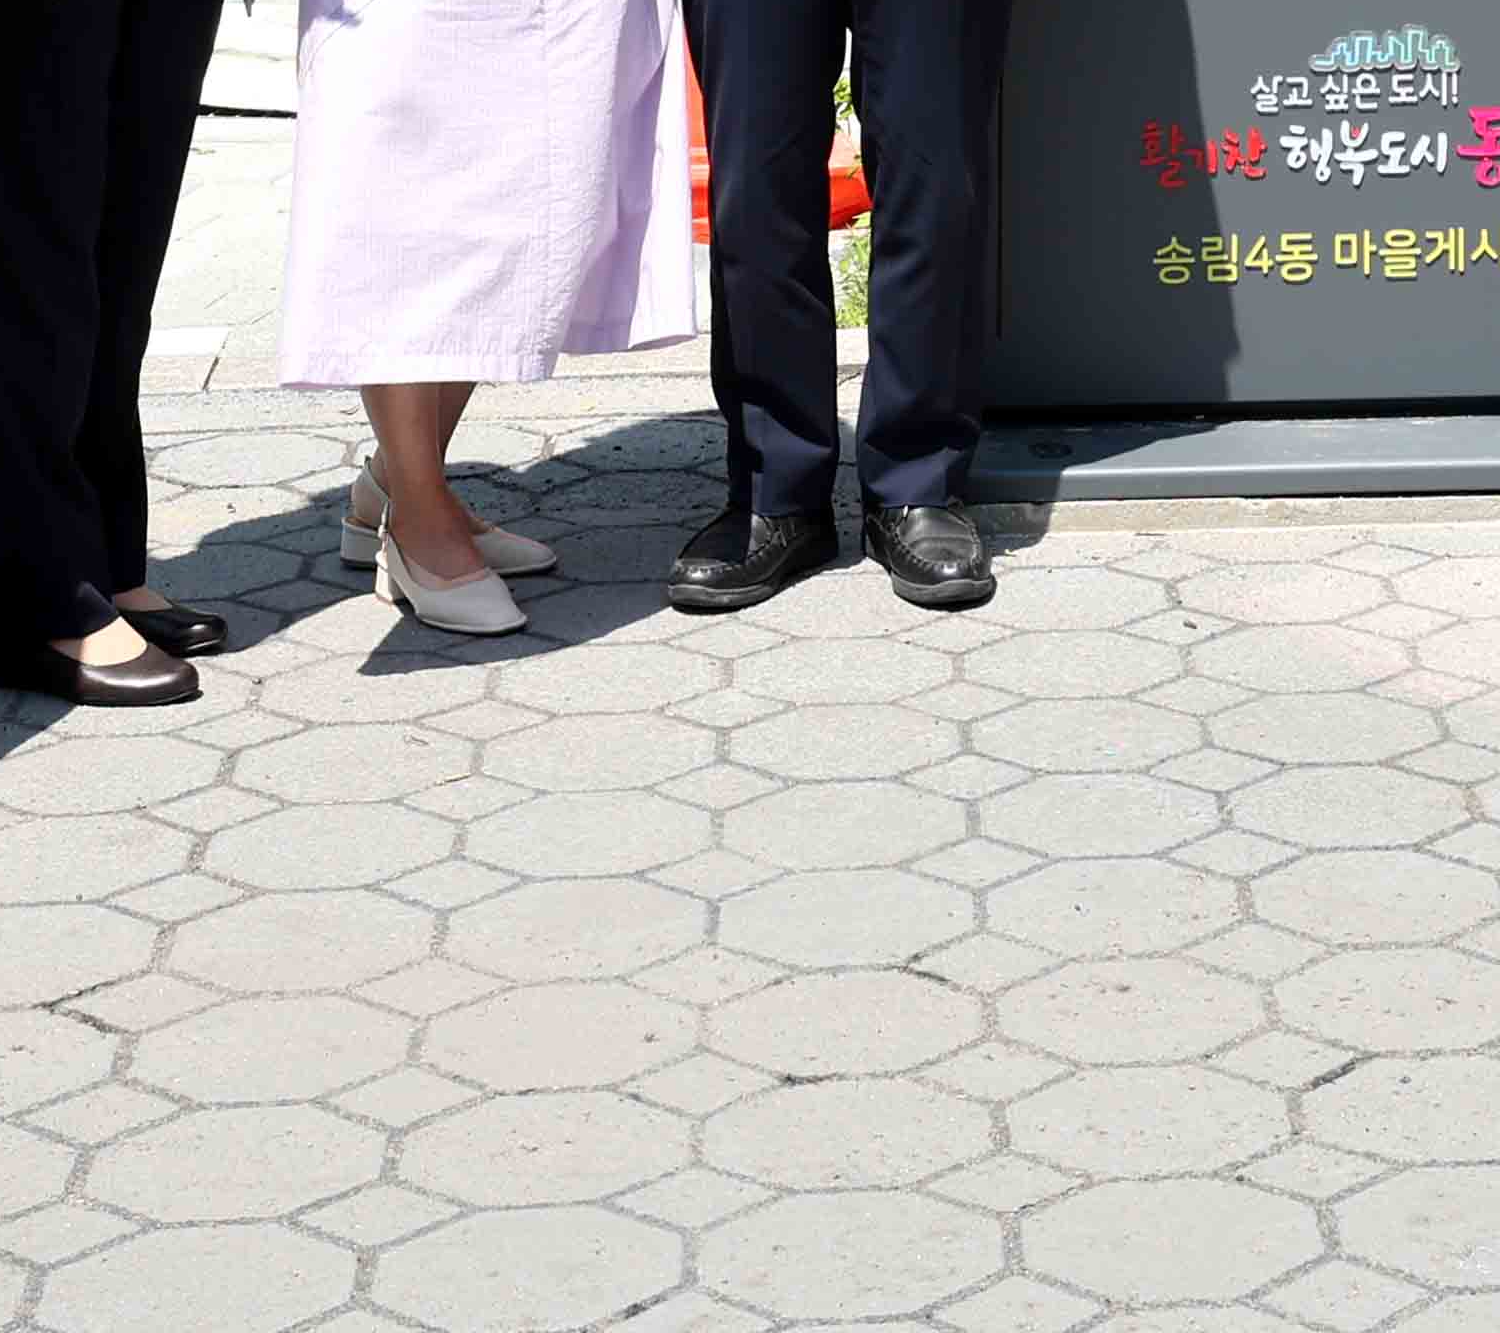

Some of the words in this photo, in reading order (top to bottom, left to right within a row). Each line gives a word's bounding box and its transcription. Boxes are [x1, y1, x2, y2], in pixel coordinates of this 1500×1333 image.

[1250, 75, 1313, 113] 살고
[1320, 73, 1380, 111] 싶은
[1388, 72, 1460, 108] 도시!
[1139, 119, 1268, 188] 활기찬
[1280, 119, 1448, 187] 행복도시
[1152, 233, 1319, 284] 송림4동
